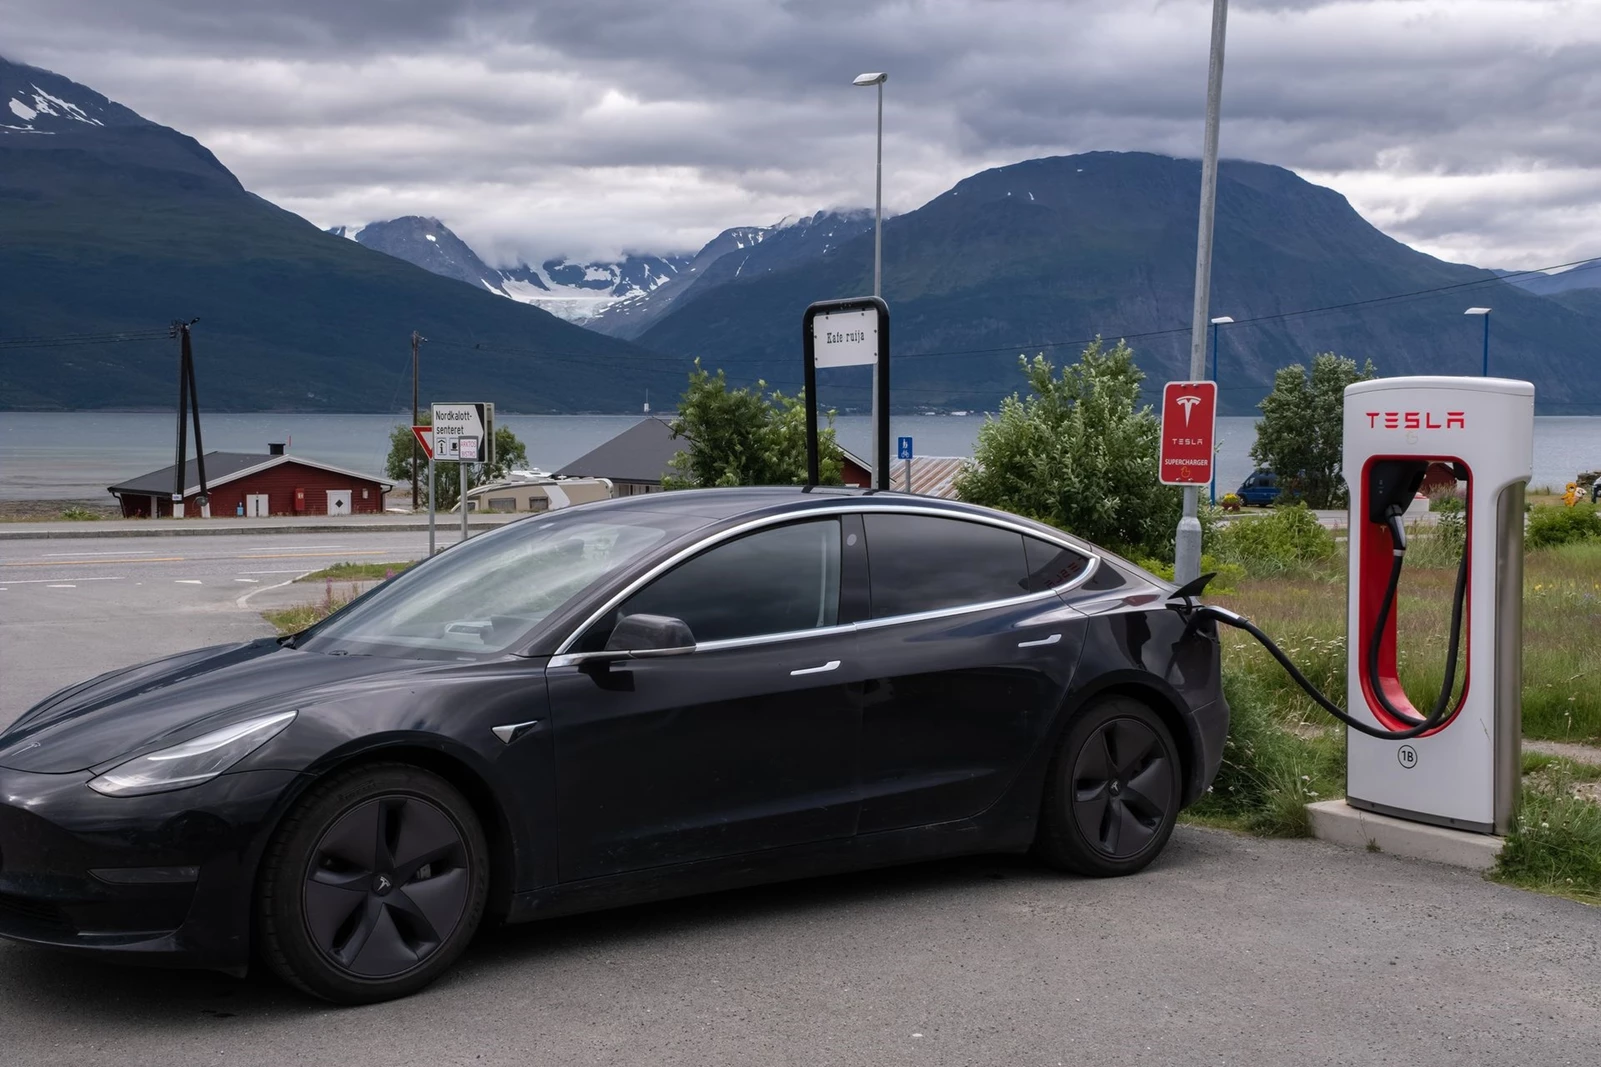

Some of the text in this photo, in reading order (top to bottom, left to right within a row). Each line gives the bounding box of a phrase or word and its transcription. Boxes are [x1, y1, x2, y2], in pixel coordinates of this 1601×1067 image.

[846, 330, 865, 343] ruija
[435, 410, 472, 421] Nordkalott-
[1365, 412, 1465, 429] TESLA
[436, 425, 464, 435] senteret
[1172, 438, 1203, 446] TESLA
[1164, 458, 1209, 466] SUPERCHARGER
[1401, 750, 1414, 762] 1B
